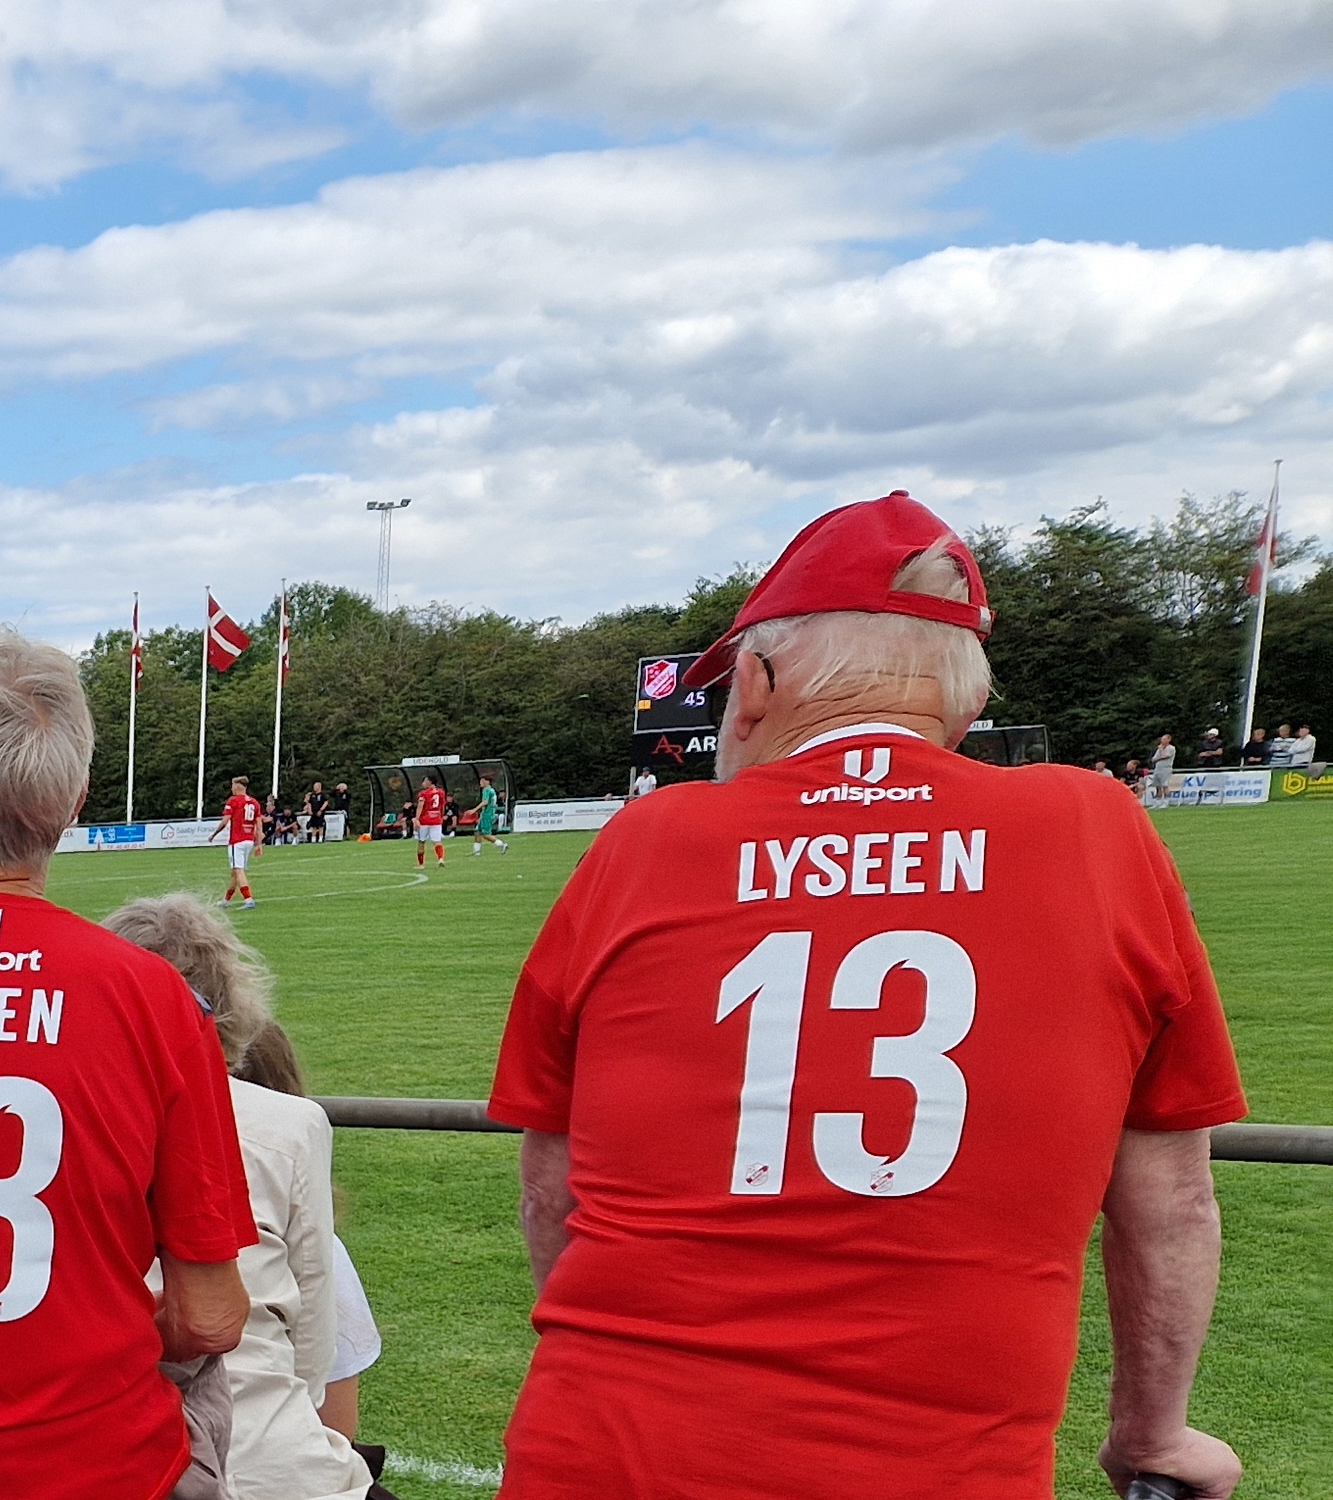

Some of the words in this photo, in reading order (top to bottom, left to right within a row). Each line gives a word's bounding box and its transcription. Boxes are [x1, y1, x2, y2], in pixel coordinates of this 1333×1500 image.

[684, 690, 706, 707] 45
[432, 793, 441, 809] 3
[800, 782, 934, 806] unisport
[715, 930, 977, 1197] 13
